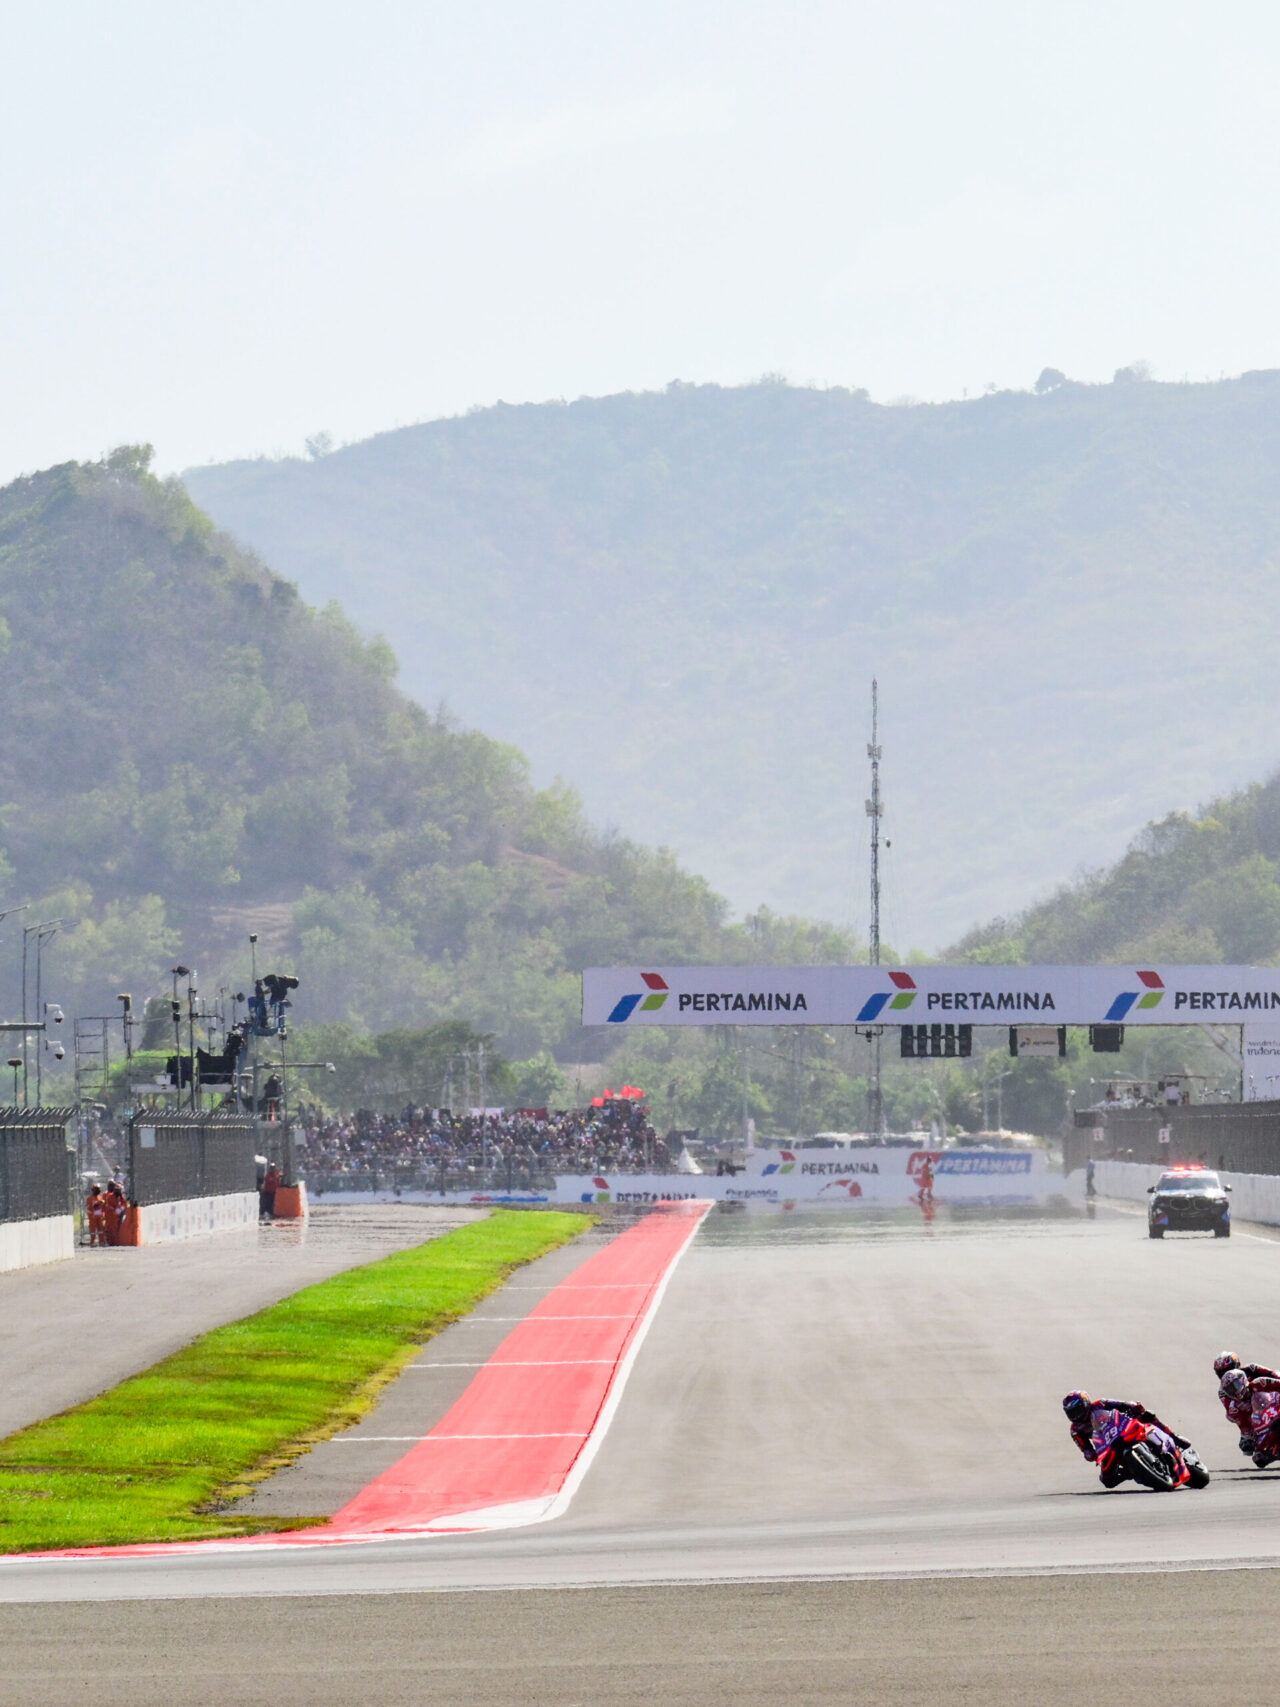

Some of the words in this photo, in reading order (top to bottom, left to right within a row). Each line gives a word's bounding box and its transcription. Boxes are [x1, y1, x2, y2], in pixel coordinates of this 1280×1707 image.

[678, 993, 808, 1012] PERTAMINA
[927, 992, 1056, 1010] PERTAMINA
[801, 1162, 879, 1176] PERTAMINA
[1262, 1406, 1278, 1425] 23
